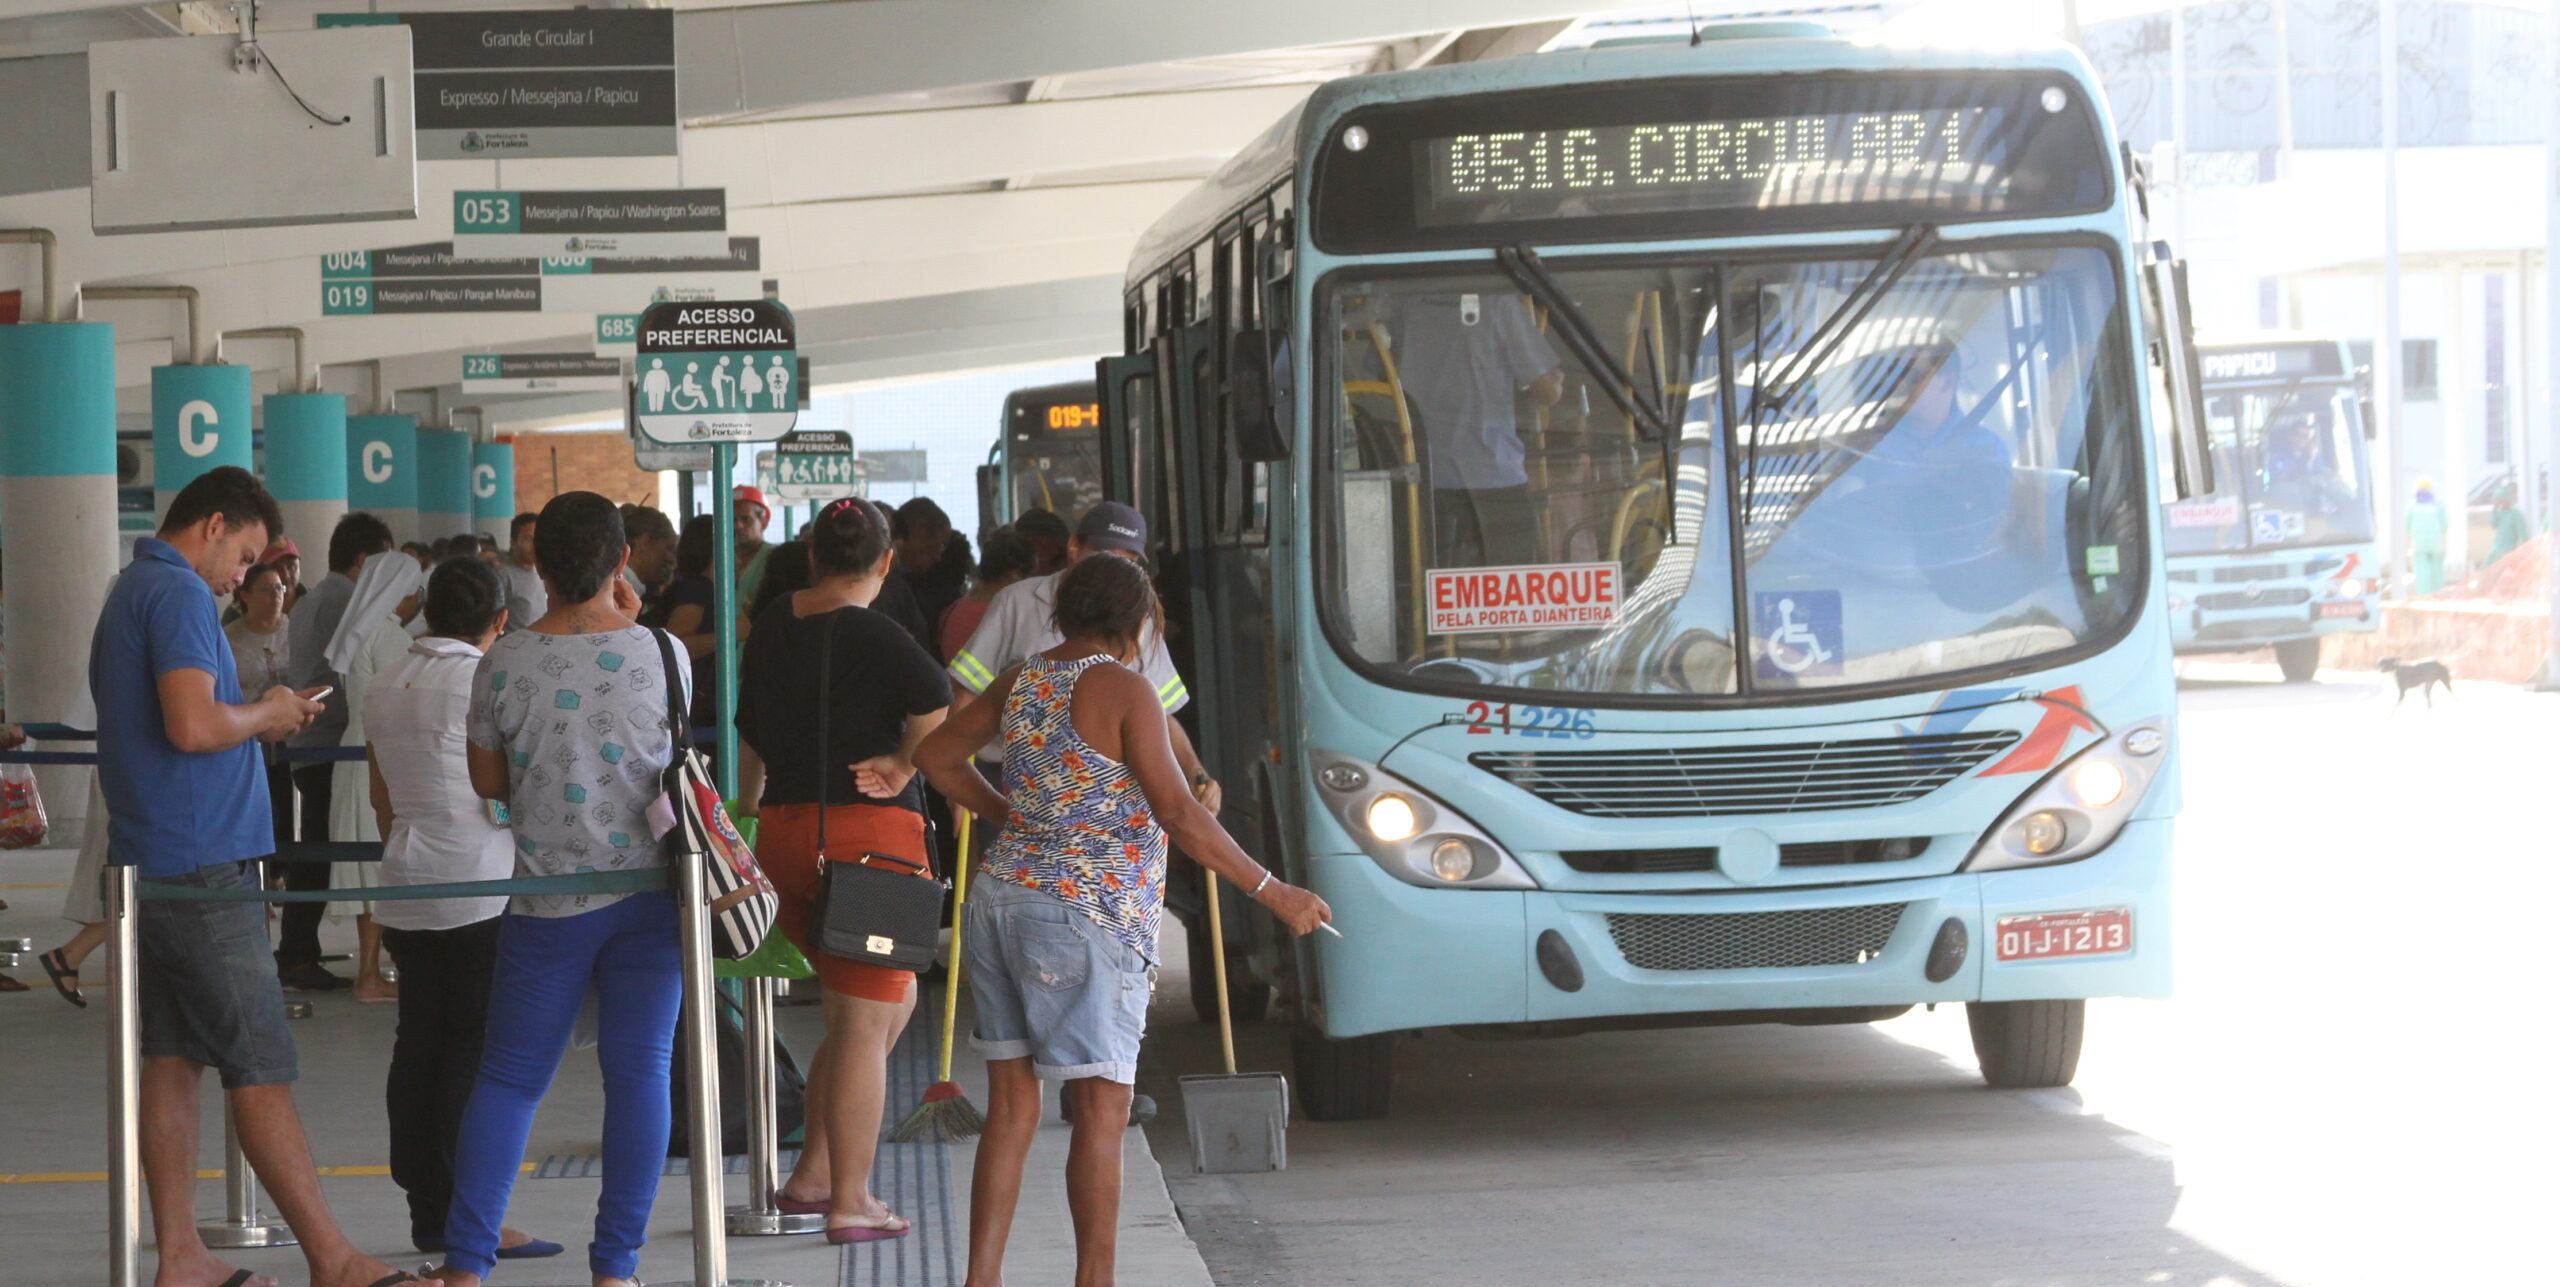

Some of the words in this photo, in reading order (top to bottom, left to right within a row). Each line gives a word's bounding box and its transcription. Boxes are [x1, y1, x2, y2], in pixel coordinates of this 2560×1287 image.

[482, 30, 531, 47] Grande
[535, 28, 586, 46] Circular
[440, 88, 499, 109] Expresso
[511, 87, 583, 109] Messejana
[595, 86, 639, 107] Papicu
[486, 139, 529, 148] Fortaleza
[462, 198, 511, 224] 053
[525, 204, 579, 222] Messejana
[587, 204, 620, 222] Papicu
[627, 202, 687, 221] Washington
[688, 202, 722, 217] Soares
[327, 250, 367, 271] 004
[386, 253, 431, 267] Messejana
[328, 286, 367, 307] 019
[379, 290, 424, 303] Messejana
[430, 288, 459, 303] Papicu
[465, 288, 494, 302] Parque
[495, 287, 536, 300] Manibura
[678, 308, 755, 325] ACESSO
[601, 318, 635, 338] 685
[646, 328, 788, 347] PREFERENCIAL
[467, 357, 497, 374] 226
[2204, 351, 2277, 378] PAPICU
[178, 400, 219, 457] C
[712, 427, 752, 437] Fortaleza
[797, 433, 836, 443] ACESSO
[781, 442, 850, 453] PREFERENCIAL
[362, 441, 393, 484] C
[473, 464, 496, 500] C
[1435, 569, 1614, 610] EMBARQUE
[1437, 612, 1474, 627] PELA
[1479, 609, 1528, 625] PORTA
[1533, 606, 1613, 623] DIANTEIRA
